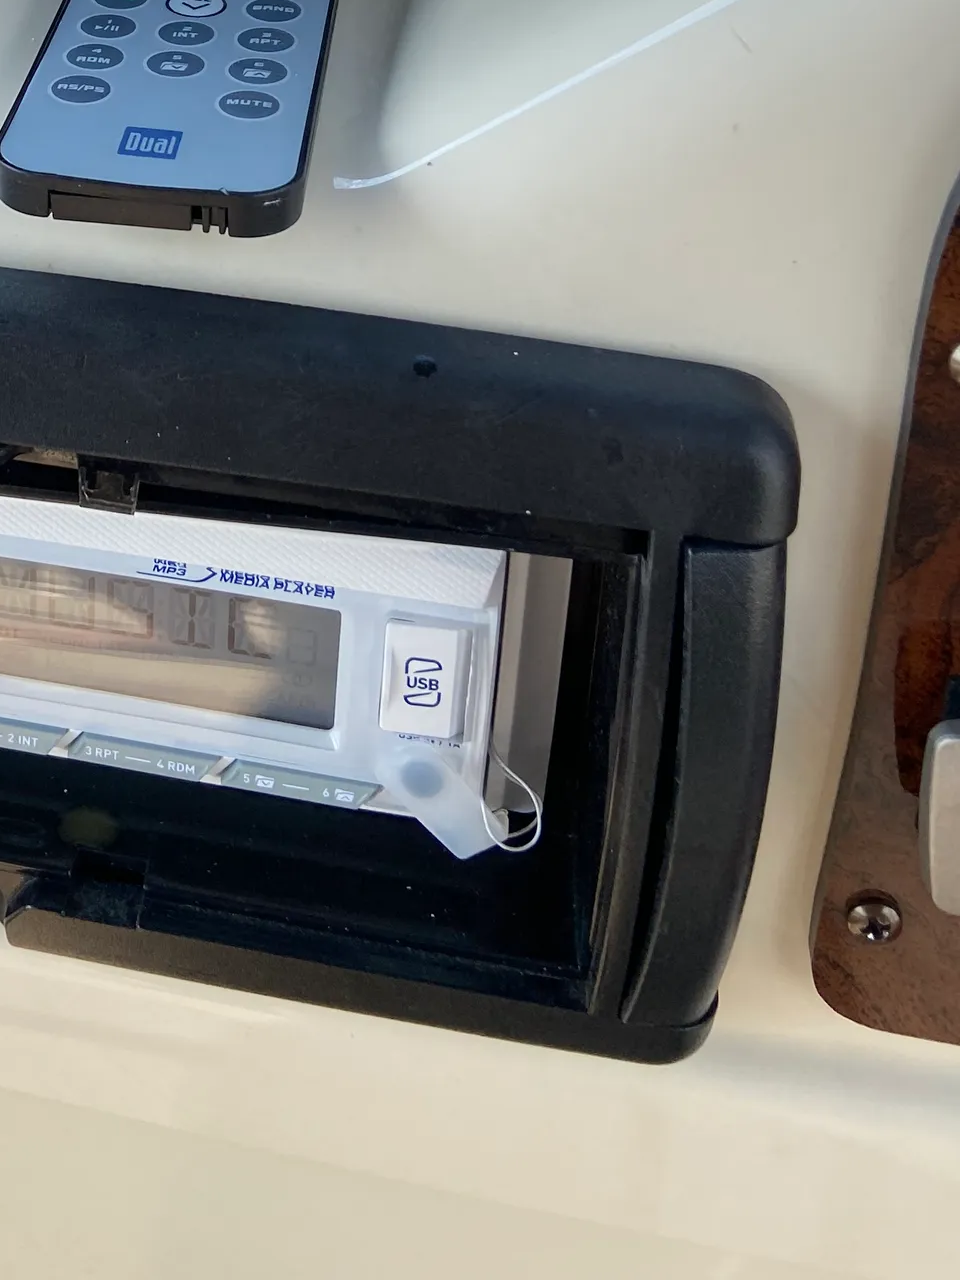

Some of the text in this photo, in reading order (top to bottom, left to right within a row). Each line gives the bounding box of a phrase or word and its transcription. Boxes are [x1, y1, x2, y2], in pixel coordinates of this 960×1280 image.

[252, 5, 295, 14] BAND
[172, 31, 199, 39] INT
[226, 98, 273, 109] MUTE
[125, 131, 178, 155] Dual
[152, 564, 187, 577] MP3
[406, 675, 440, 691] USB
[7, 733, 39, 748] 2 INT
[85, 746, 120, 761] 3 RPT
[156, 758, 196, 775] 4 RDM
[243, 773, 250, 784] 5
[322, 787, 330, 798] 6
